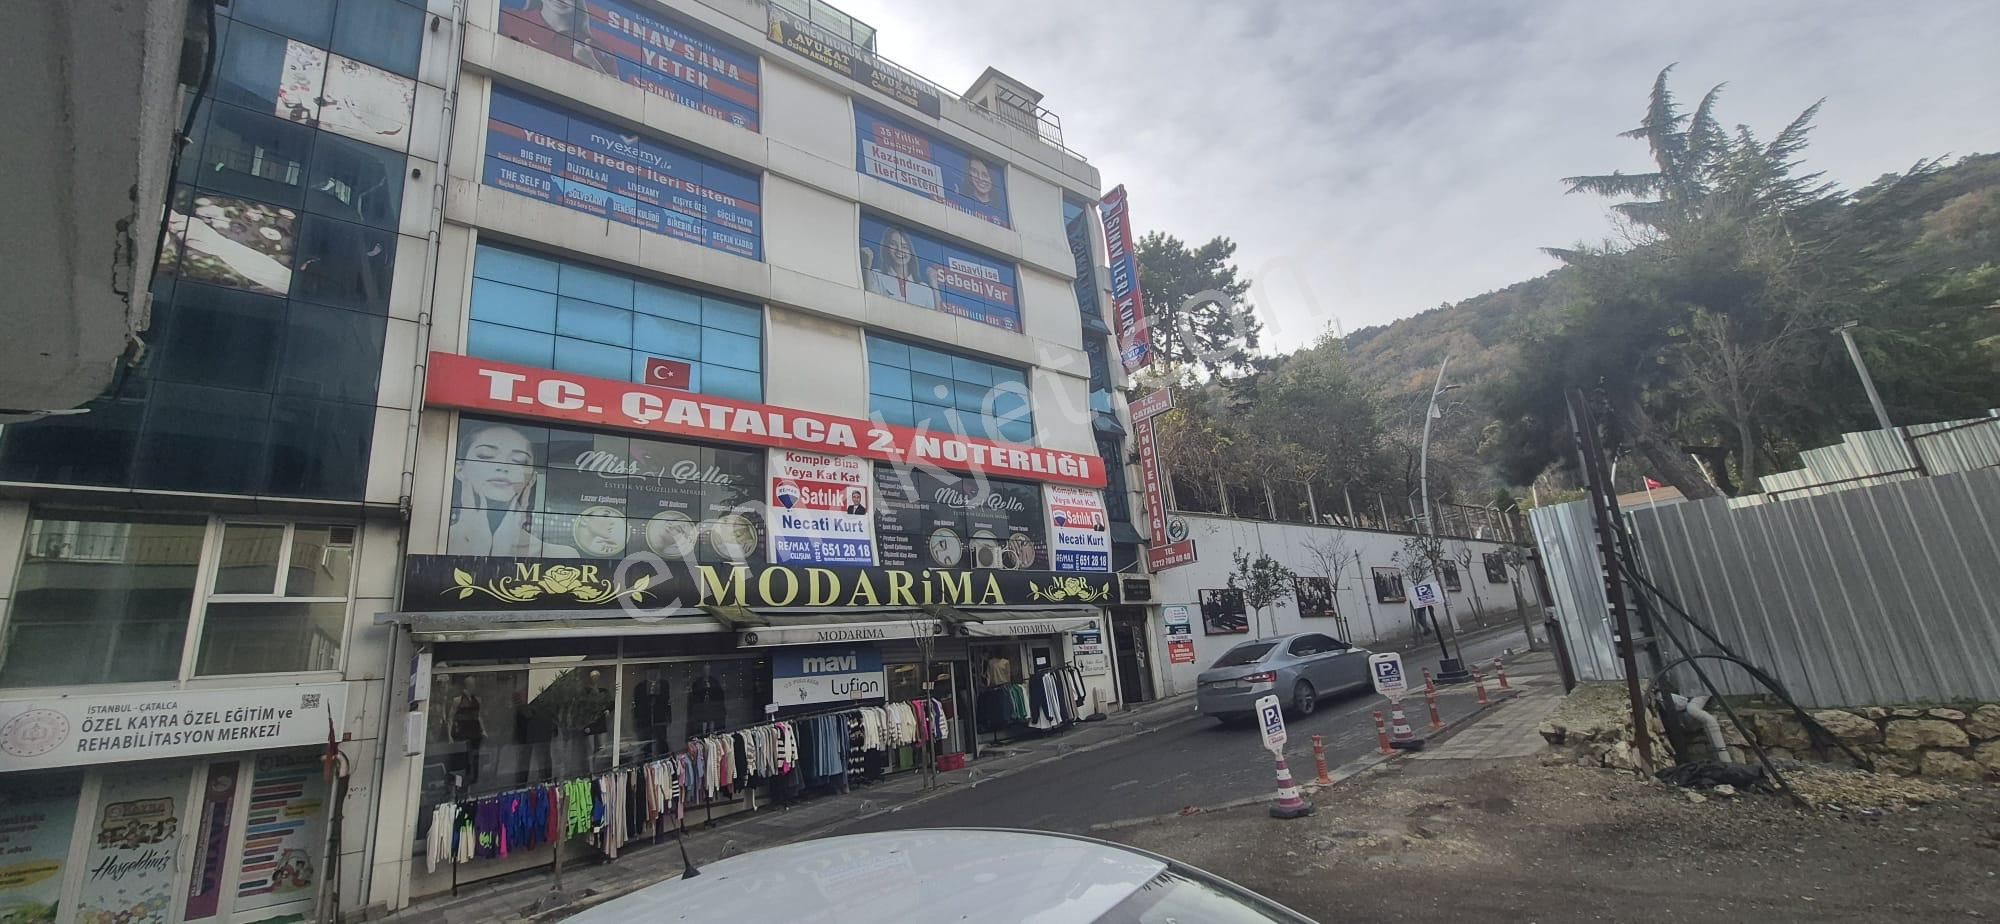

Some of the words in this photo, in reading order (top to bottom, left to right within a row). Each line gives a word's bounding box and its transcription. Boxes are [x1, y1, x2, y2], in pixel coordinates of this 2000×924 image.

[608, 10, 676, 52] SINAV
[684, 44, 740, 81] SANA
[795, 34, 850, 65] AVUKAT
[643, 48, 710, 90] YETER
[872, 70, 919, 98] AVUKAT
[520, 148, 534, 160] BIG
[536, 154, 552, 166] FIVE
[591, 134, 662, 166] myexamy
[872, 146, 934, 177] Kazandıran
[500, 168, 518, 182] THE
[520, 174, 540, 188] SELF
[542, 180, 550, 192] ID
[524, 129, 588, 160] Yüksek
[593, 151, 641, 177] Hedef
[685, 182, 736, 207] Sistem
[900, 170, 939, 194] Sistem
[937, 268, 984, 296] Sebebi
[986, 284, 1008, 302] Var
[1106, 216, 1124, 260] SINAV
[1118, 297, 1136, 338] KURS
[478, 368, 602, 414] T.C.
[621, 392, 858, 449] ÇATALCA
[868, 428, 904, 454] 2.
[915, 435, 1090, 479] NOTERLİĞİ
[575, 450, 641, 477] Miss
[672, 459, 733, 487] Bella
[786, 451, 830, 467] Komple
[834, 457, 858, 469] Bina
[784, 466, 813, 480] Veya
[816, 470, 837, 480] Kat
[840, 472, 860, 482] Kat
[801, 486, 844, 507] Satılık
[934, 487, 970, 506] Miss
[988, 493, 1024, 512] Bella
[1052, 485, 1078, 496] Komple
[1072, 498, 1084, 506] Kat
[782, 515, 830, 531] Necati
[834, 518, 864, 533] Kurt
[1066, 510, 1092, 526] Satılık
[778, 541, 810, 551] RE/MAX
[822, 543, 840, 557] 651
[843, 544, 856, 557] 28
[858, 544, 870, 557] 18
[1059, 532, 1085, 546] Necati
[1087, 535, 1104, 546] Kurt
[1056, 554, 1074, 562] RE/MAX
[1080, 554, 1090, 566] 651
[1091, 555, 1099, 566] 28
[1100, 556, 1107, 566] 18
[802, 650, 856, 673] mavi
[831, 678, 879, 695] Lufian
[88, 704, 132, 714] İSTANBUL
[139, 701, 178, 713] ÇATALCA
[82, 716, 122, 733] ÖZEL
[128, 714, 178, 730] KAYRA
[183, 710, 220, 726] ÖZEL
[224, 707, 274, 723] EĞİTİM
[278, 709, 294, 719] ve
[76, 729, 214, 752] REHABİLİTASYON
[218, 722, 281, 741] MERKEZİ
